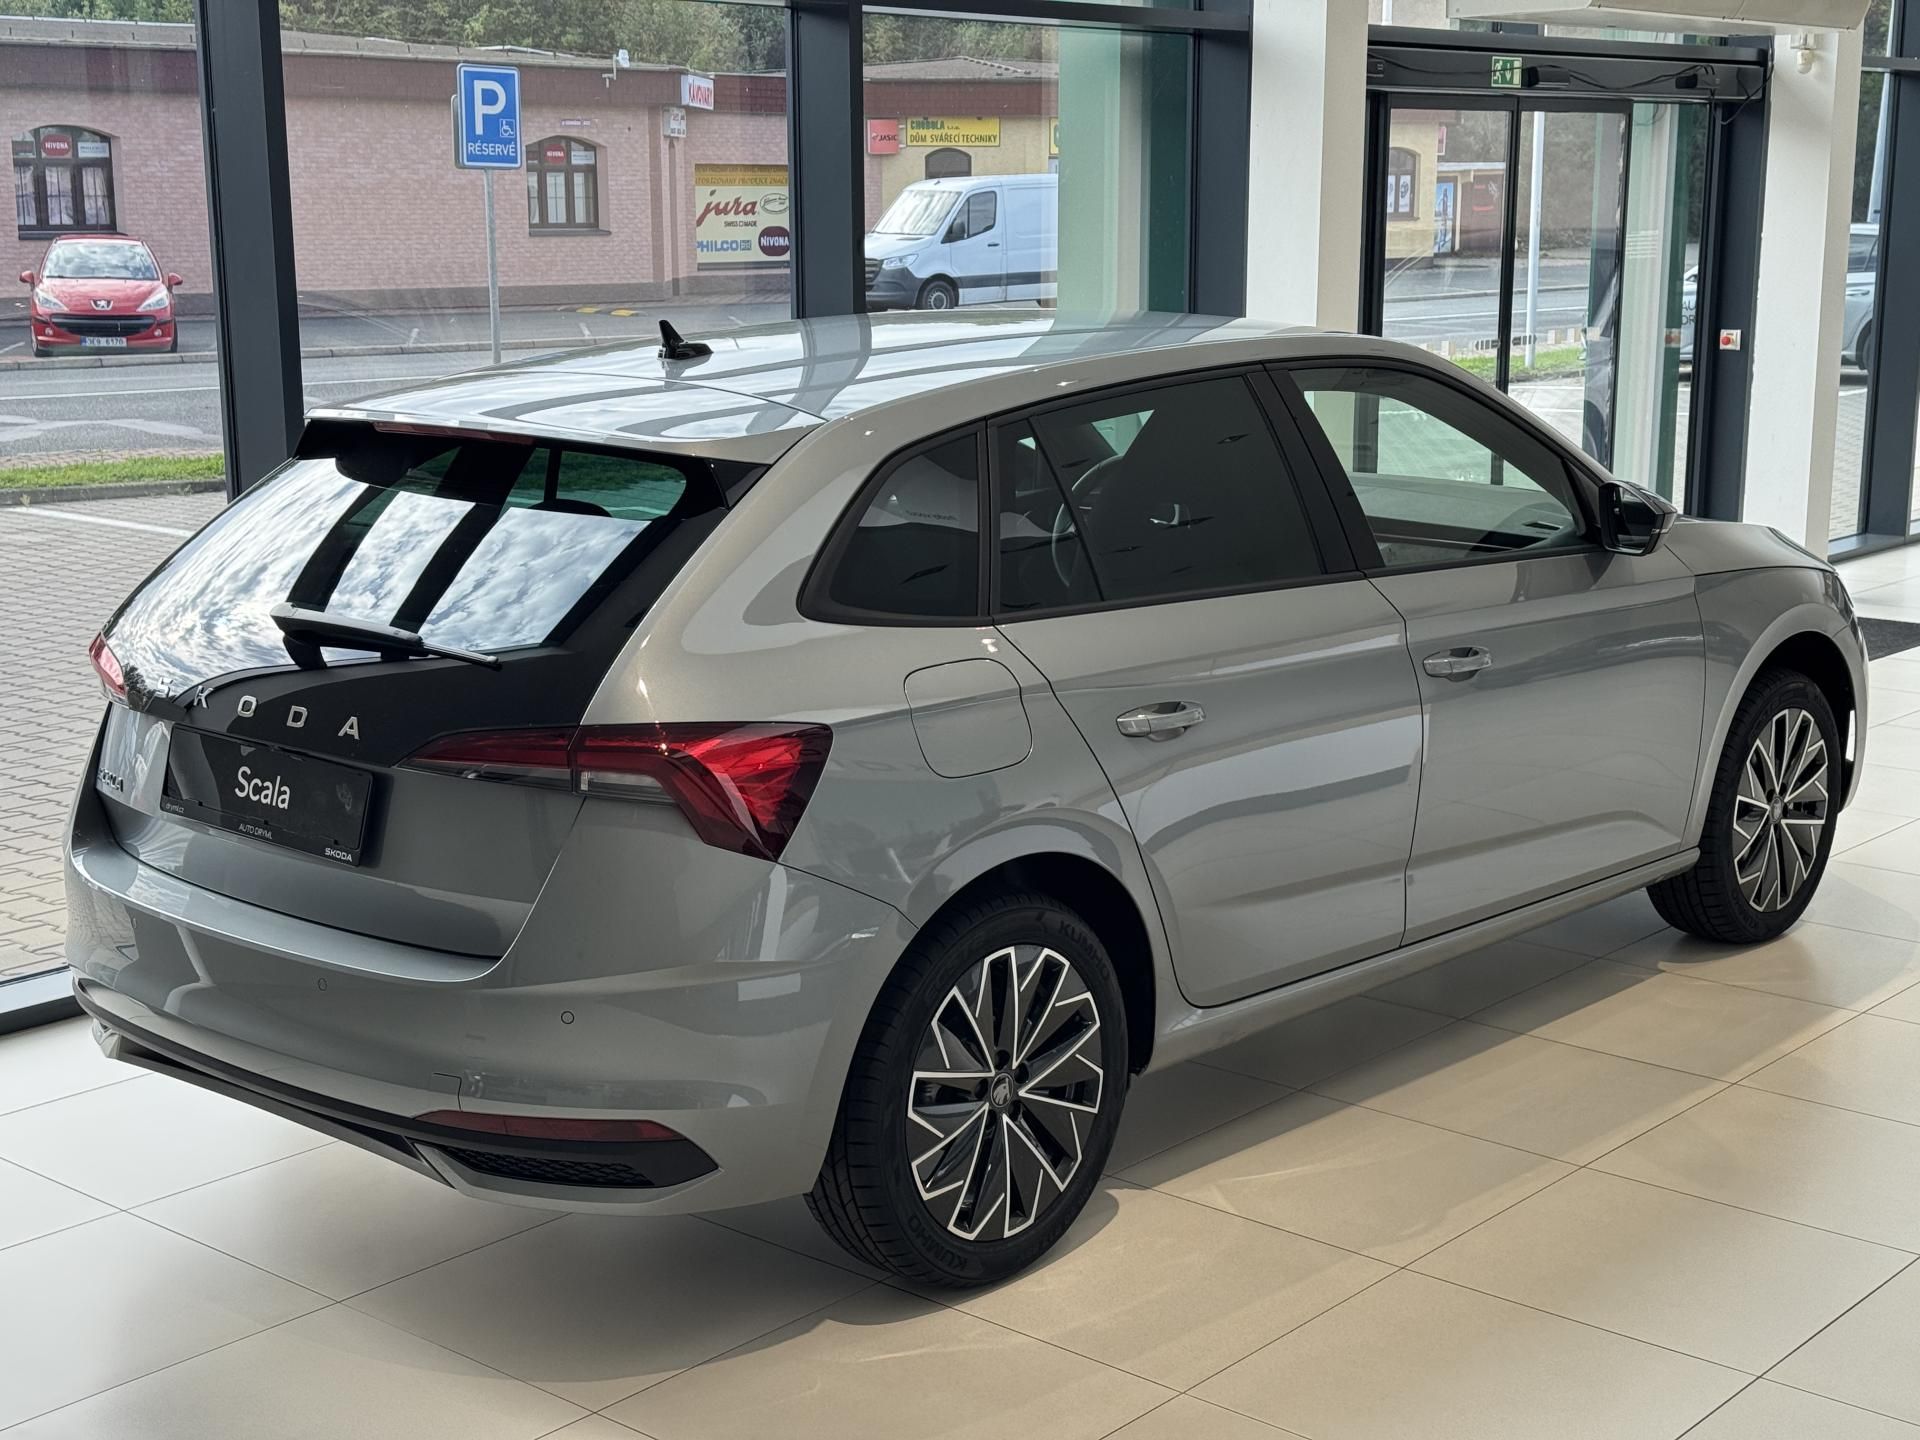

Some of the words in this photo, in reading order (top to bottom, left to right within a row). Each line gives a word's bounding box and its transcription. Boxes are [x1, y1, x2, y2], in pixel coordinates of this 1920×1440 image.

[473, 79, 507, 136] P
[909, 132, 927, 143] DŮM
[930, 132, 960, 143] SVÁŘECÍ
[961, 133, 998, 143] TECHNIKY
[467, 140, 517, 157] RÉSERVÉ
[696, 189, 758, 228] jura
[695, 239, 740, 253] PHILCO
[760, 234, 790, 247] NIVONA
[234, 766, 292, 810] Scala
[238, 823, 255, 834] AUTO
